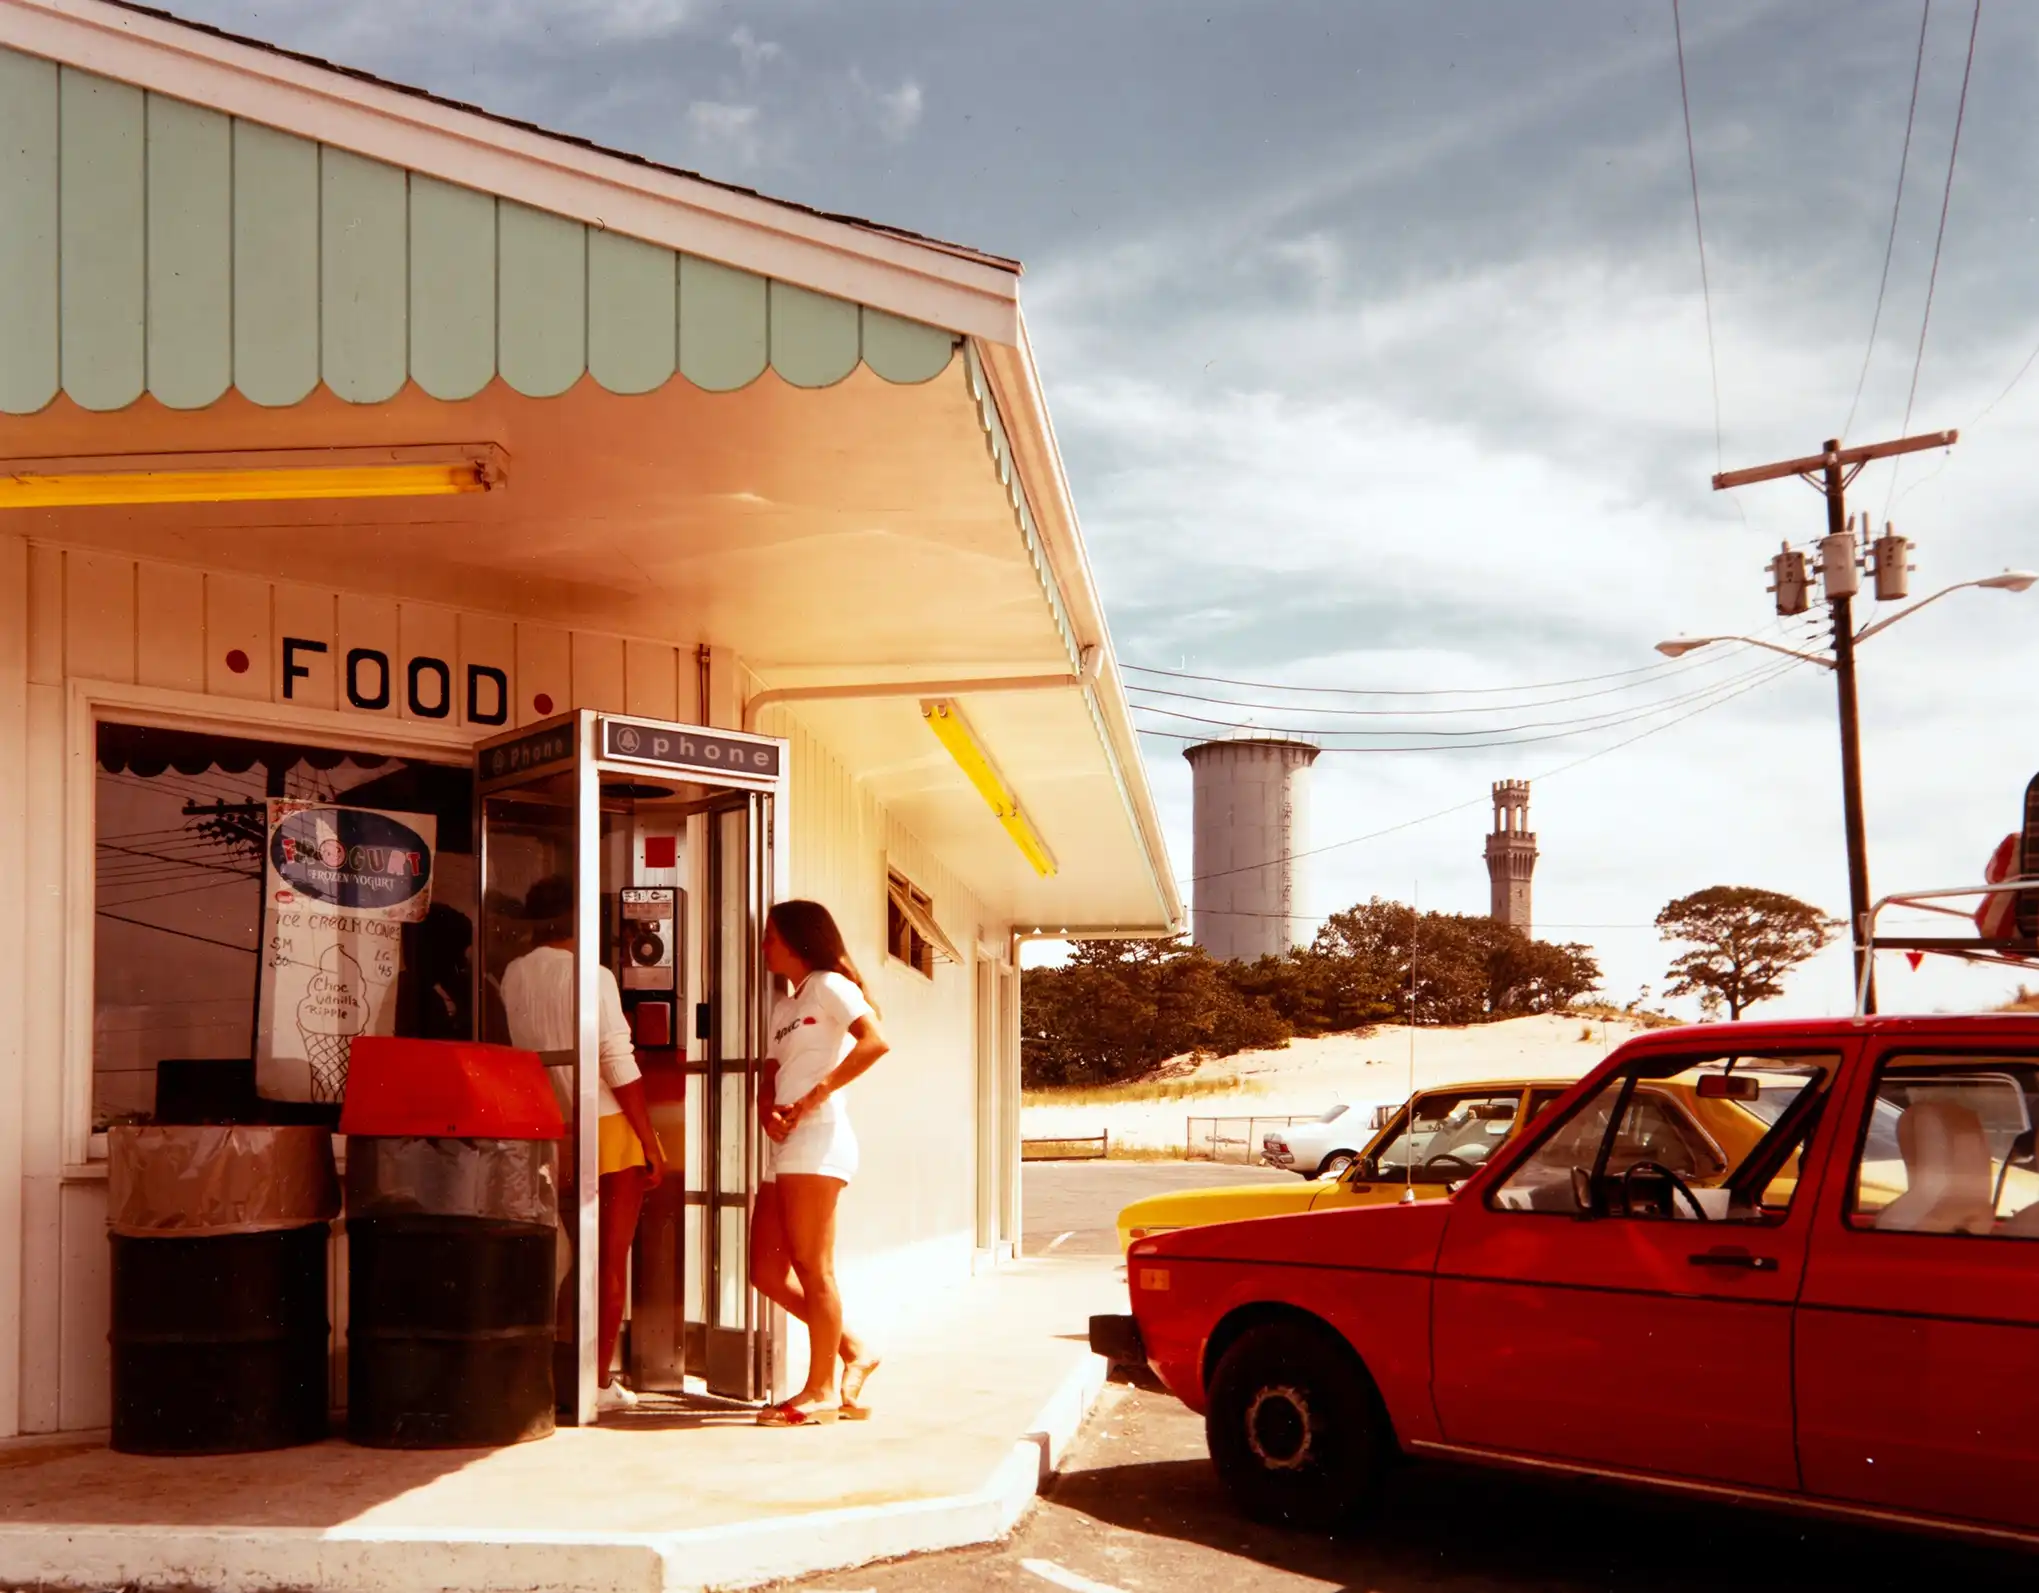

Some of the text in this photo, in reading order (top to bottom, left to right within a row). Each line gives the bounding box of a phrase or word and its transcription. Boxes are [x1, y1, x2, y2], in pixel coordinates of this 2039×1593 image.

[282, 637, 508, 726] FOOD
[510, 738, 563, 768] phone
[653, 735, 771, 767] phone
[308, 869, 395, 892] FROZEN YOGURT
[269, 936, 293, 952] SM
[313, 976, 349, 993] Choc
